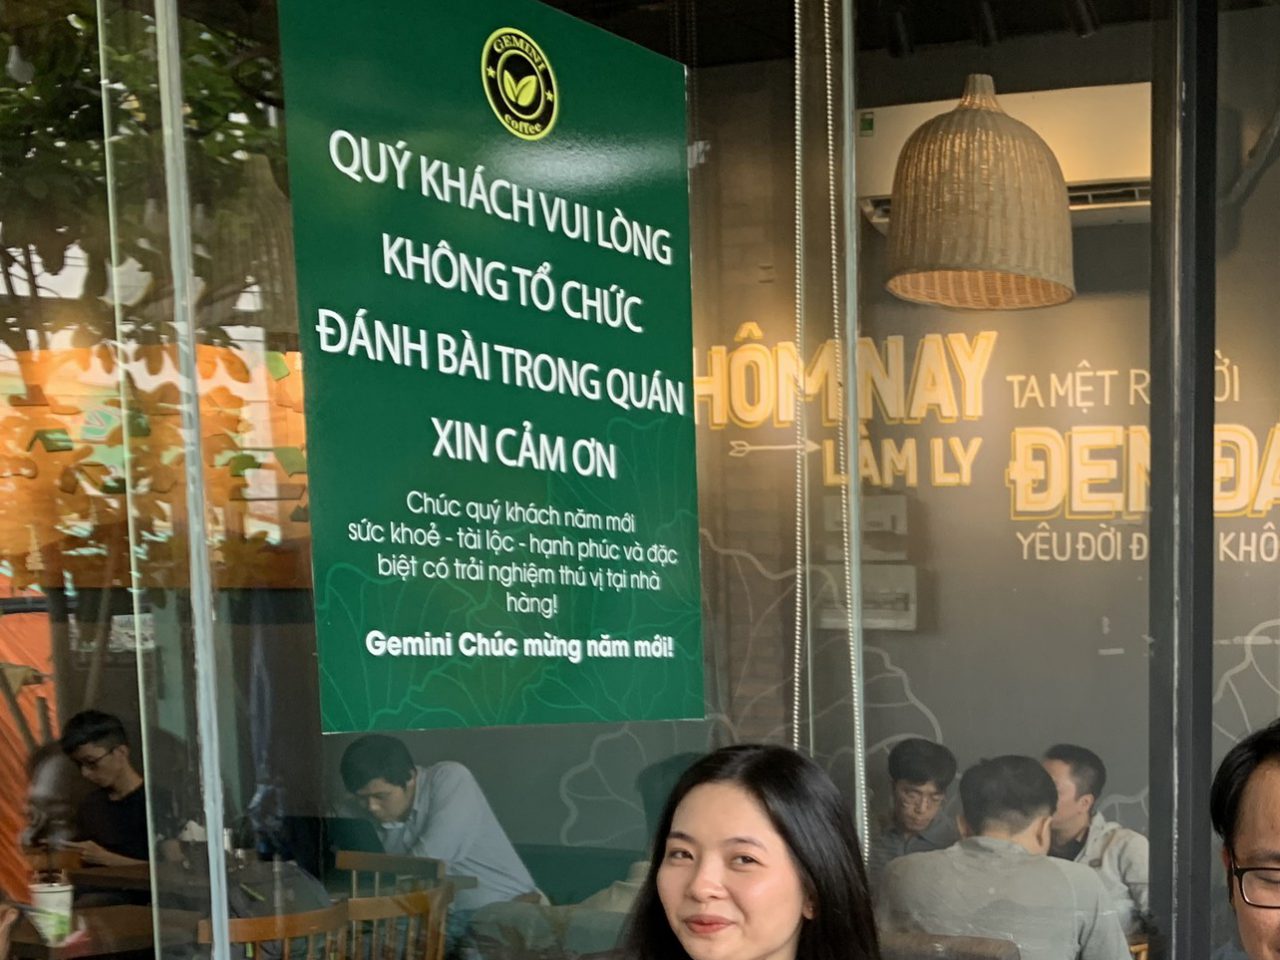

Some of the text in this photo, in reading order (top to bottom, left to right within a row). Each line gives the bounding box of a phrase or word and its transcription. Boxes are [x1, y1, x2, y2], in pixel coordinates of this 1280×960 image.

[493, 35, 546, 71] GEMINI
[504, 113, 542, 135] coffee
[329, 130, 673, 265] QUÝ KHÁCH VUI LÒNG
[382, 233, 644, 333] KHÔNG TỔ CHỨC
[316, 308, 685, 416] ĐÁNH BÀI TRONG QUÁN
[693, 321, 998, 430] HÔM NAY
[1006, 374, 1045, 409] TA
[1050, 359, 1119, 414] MỆT
[431, 417, 618, 479] XIN CẢM ƠN
[930, 437, 983, 488] LY
[406, 490, 636, 533] Chúc quý khách năm mới
[348, 518, 385, 542] sức
[390, 521, 441, 546] khoẻ
[457, 527, 482, 549] tài
[486, 530, 515, 555] lộc
[529, 533, 575, 559] hạnh
[578, 538, 621, 561] phúc
[624, 541, 645, 562] và
[647, 544, 678, 566] đặc
[1016, 521, 1072, 562] YÊU
[1076, 522, 1123, 562] ĐỜI
[377, 553, 662, 592] biệt có trải nghiệm thú vị tại nhà
[506, 592, 558, 618] hàng!
[365, 630, 674, 663] Gemini Chúc mừng năm mới!
